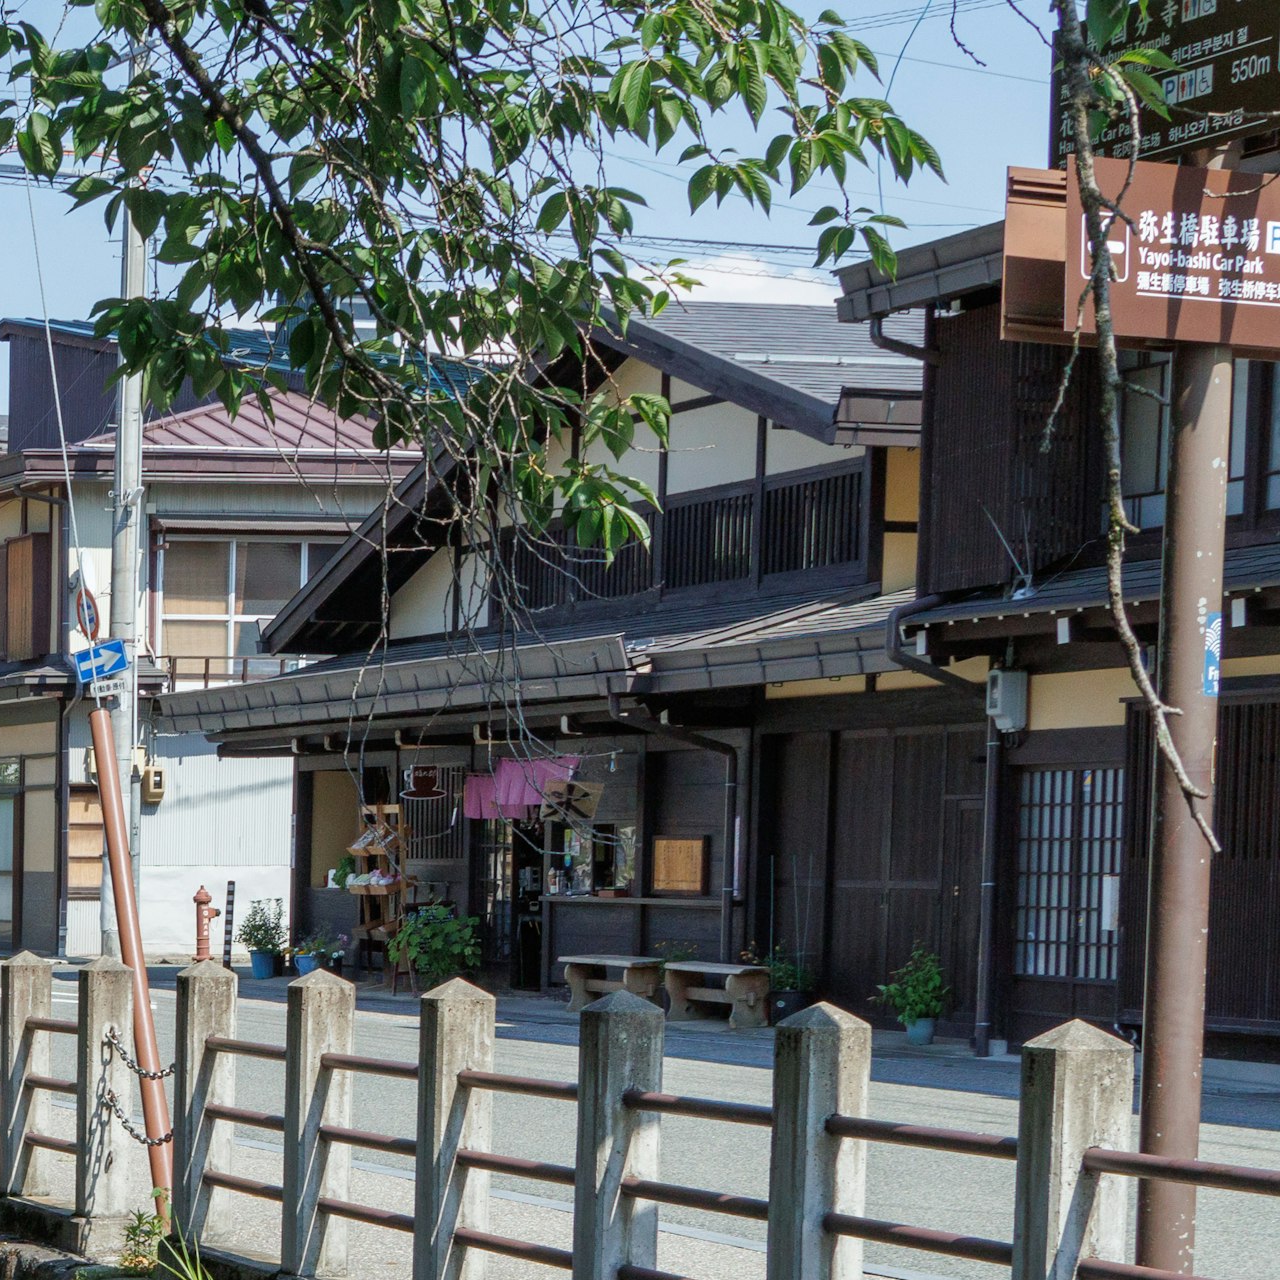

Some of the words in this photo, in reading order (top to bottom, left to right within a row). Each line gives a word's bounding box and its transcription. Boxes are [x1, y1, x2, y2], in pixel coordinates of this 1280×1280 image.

[1231, 55, 1271, 84] 550m
[1101, 127, 1117, 142] Car
[1168, 118, 1209, 142] 하나오카
[1138, 210, 1260, 252] 弥生橋駐車場
[1138, 247, 1211, 270] Yayoi-bashi
[1212, 253, 1236, 272] Car
[1236, 256, 1264, 274] Park
